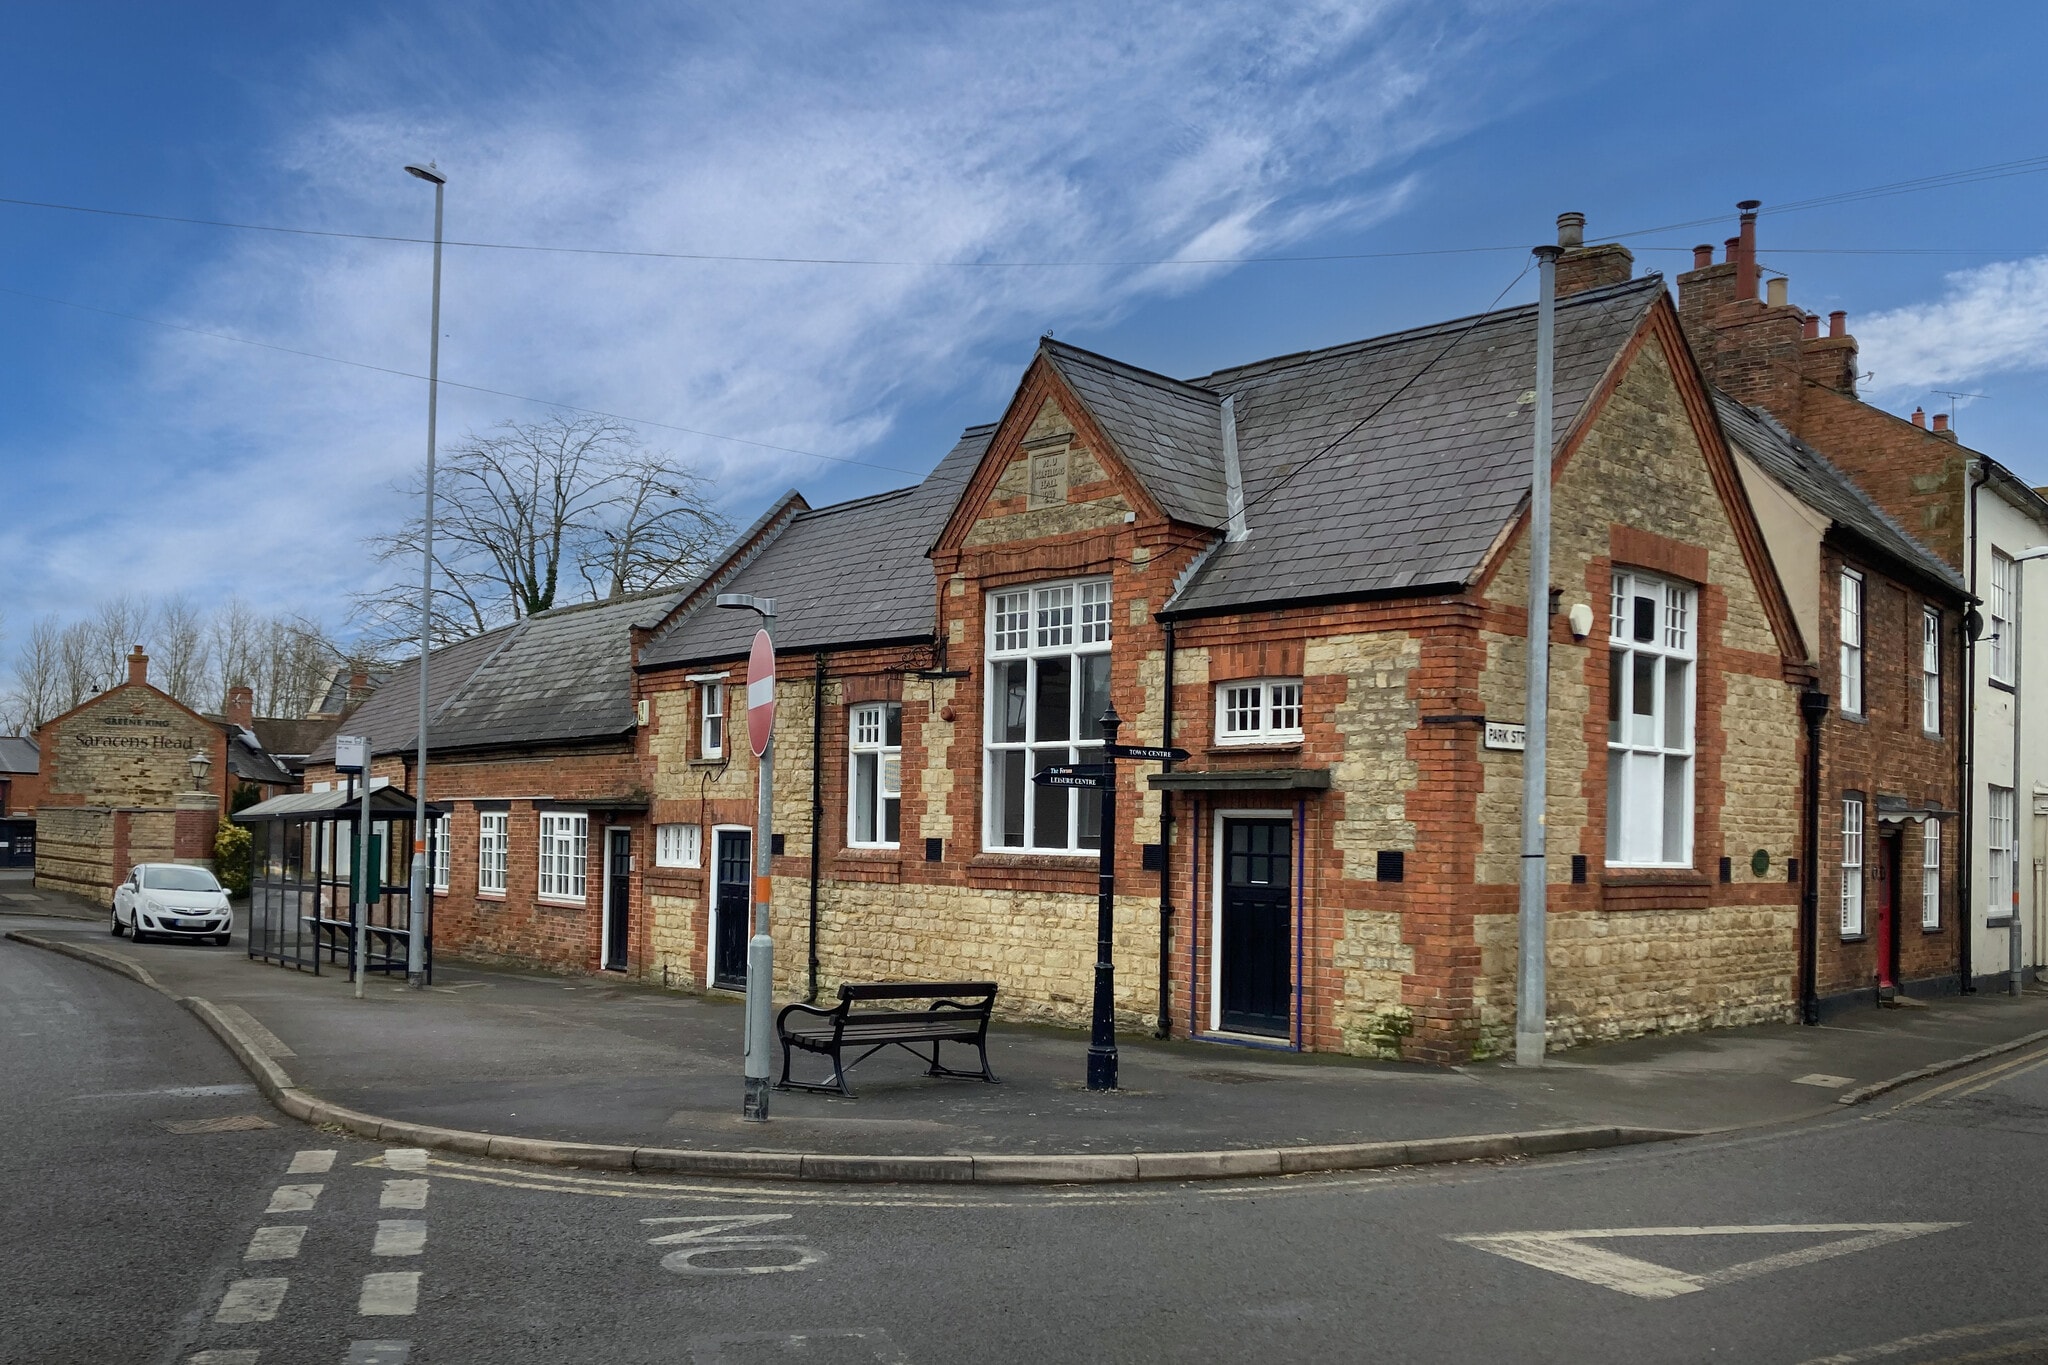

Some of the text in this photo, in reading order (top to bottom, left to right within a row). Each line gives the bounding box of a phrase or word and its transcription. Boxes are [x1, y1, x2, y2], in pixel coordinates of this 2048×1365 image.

[104, 717, 170, 728] GREENE KING
[76, 733, 194, 750] Saracens Head
[1488, 728, 1525, 744] PARK STR
[1129, 749, 1172, 758] TOWN CENTRE
[1050, 776, 1097, 786] LEISURE CENTRE
